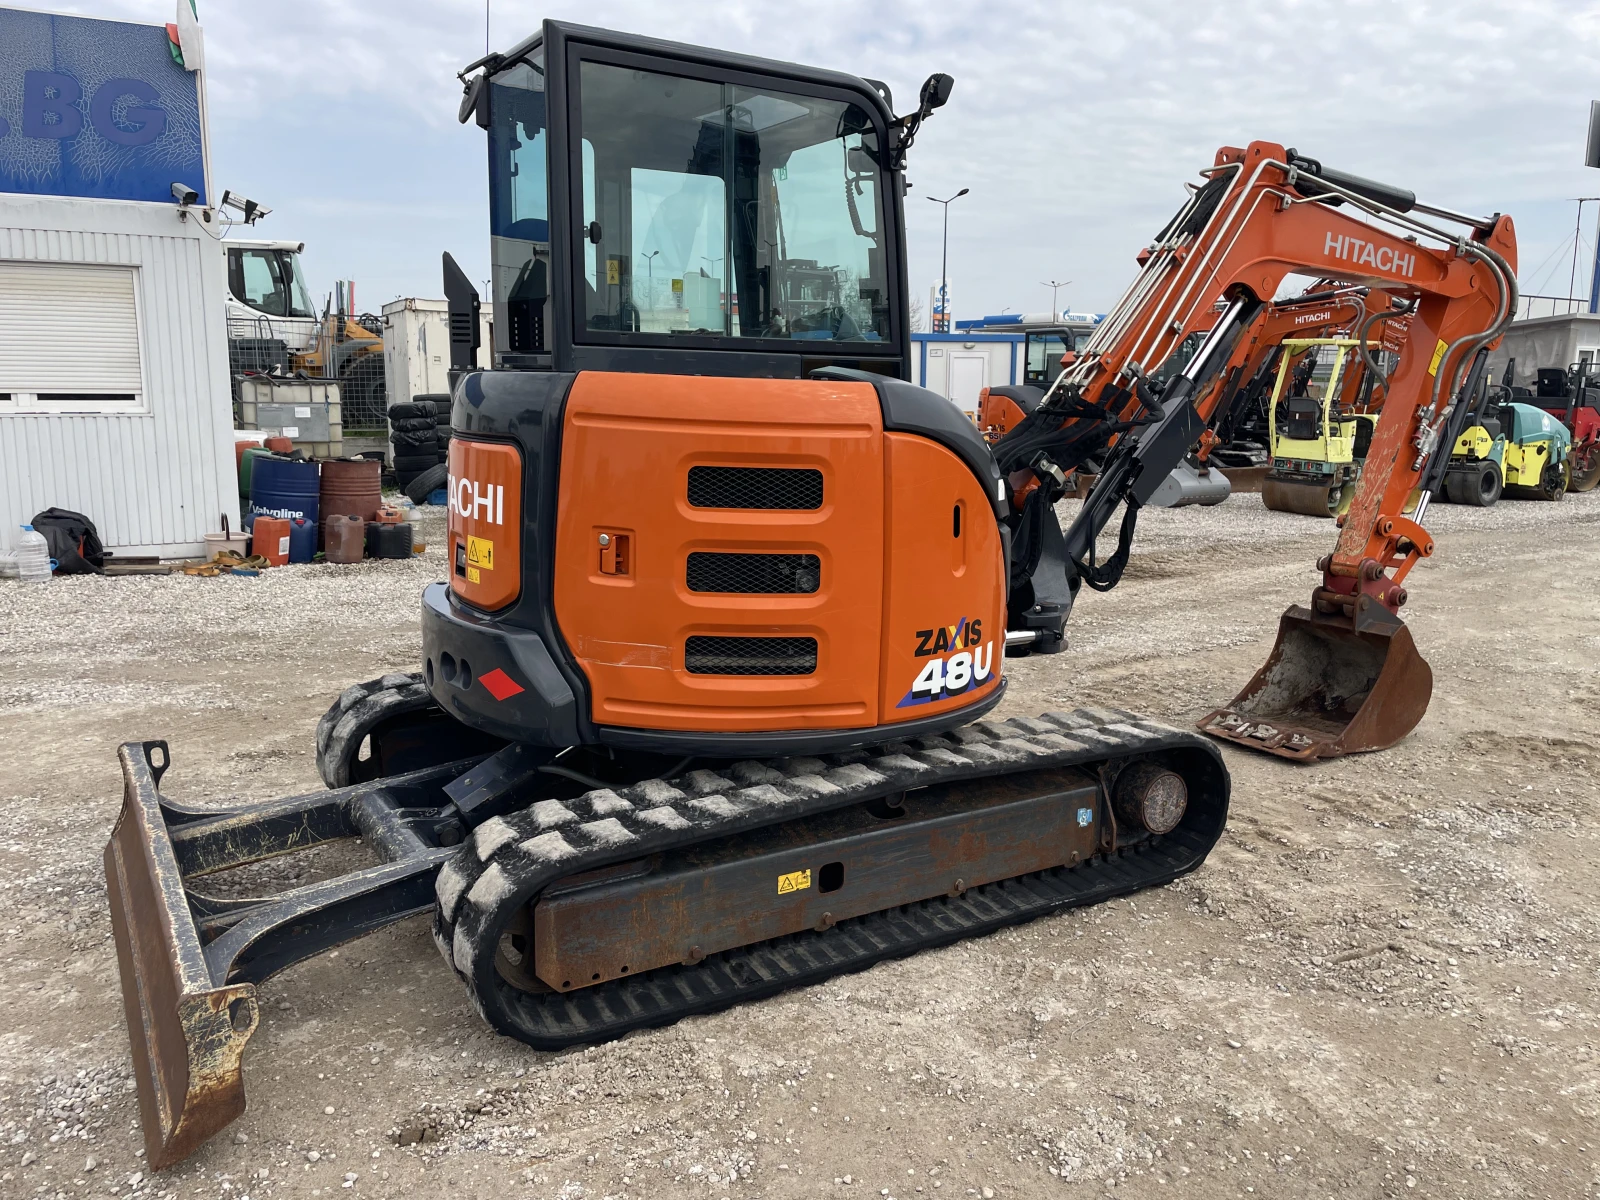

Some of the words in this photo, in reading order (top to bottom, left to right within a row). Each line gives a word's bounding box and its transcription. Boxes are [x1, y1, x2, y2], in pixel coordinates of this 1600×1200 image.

[1323, 231, 1416, 278] HITACHI
[1295, 311, 1331, 325] HITACHI
[252, 504, 304, 519] Valvoline
[914, 616, 982, 657] ZAXIS
[911, 640, 993, 701] 48U
